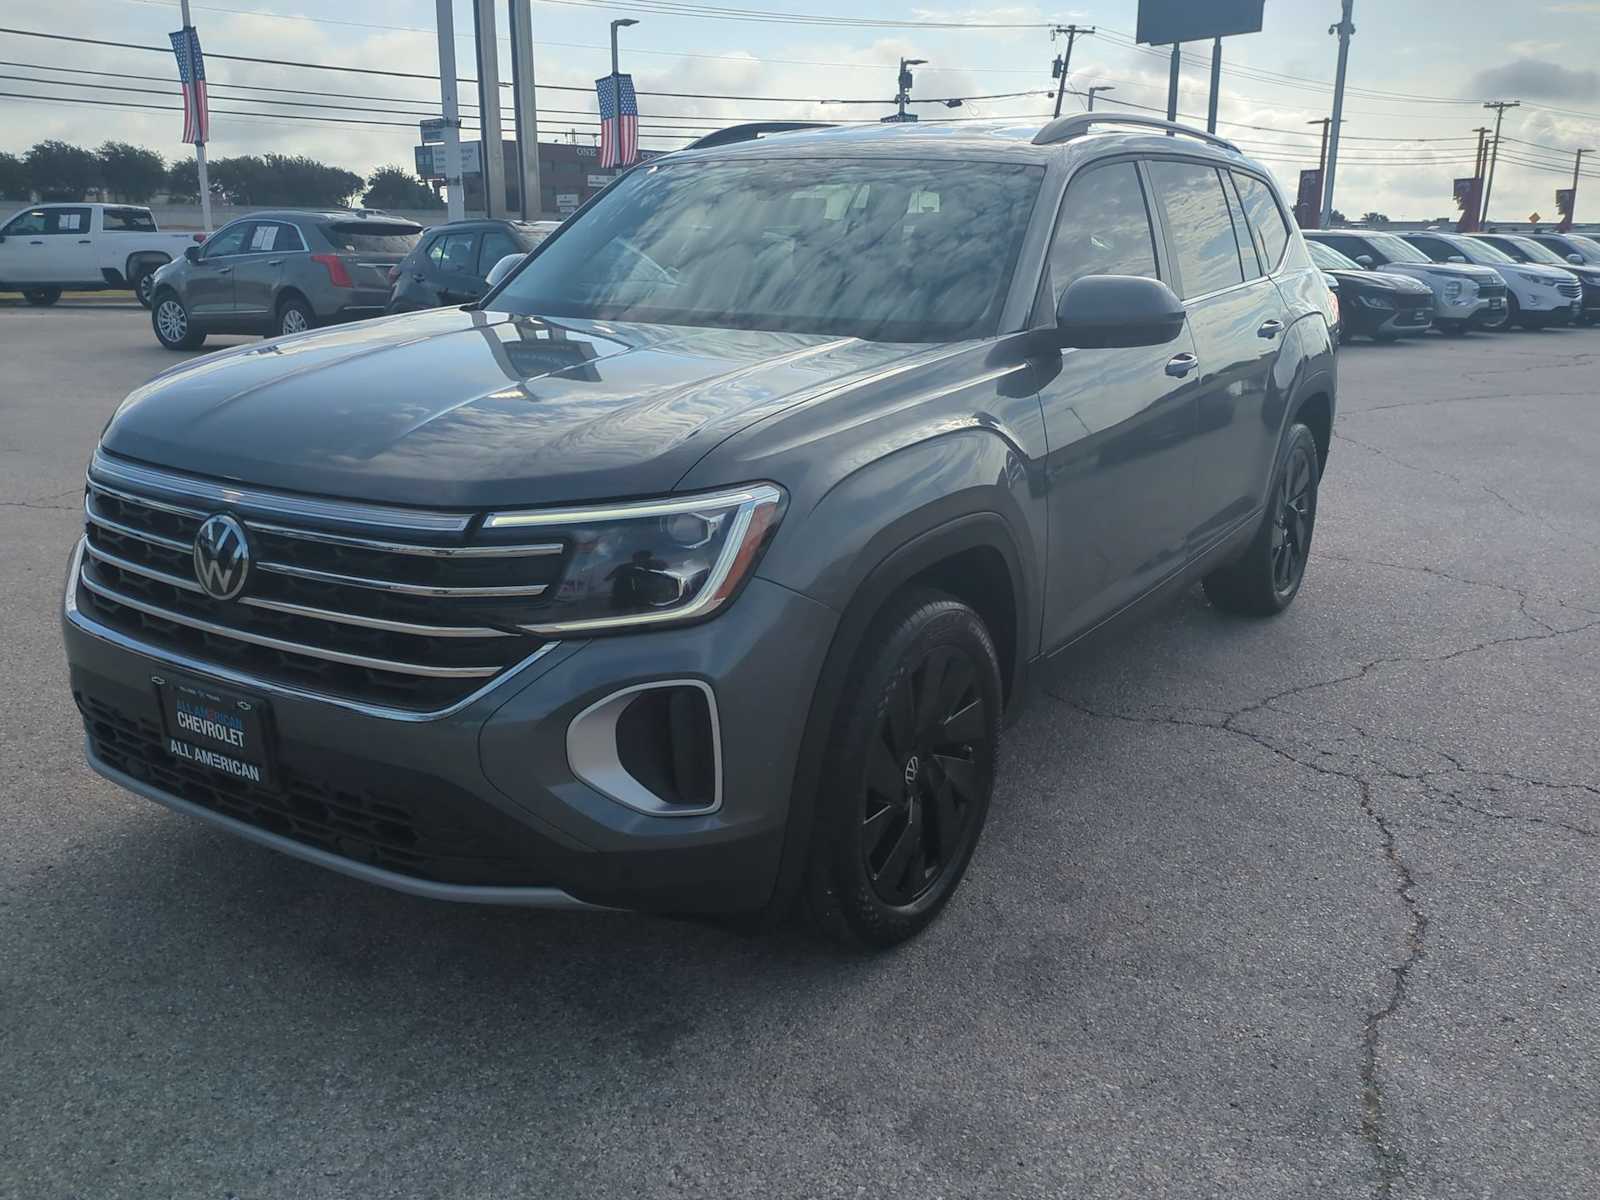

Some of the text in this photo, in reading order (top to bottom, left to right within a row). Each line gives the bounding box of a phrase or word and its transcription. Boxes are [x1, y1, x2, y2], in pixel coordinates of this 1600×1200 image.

[177, 711, 244, 748] CHEVROLET
[170, 739, 260, 782] ALL AMERICAN
